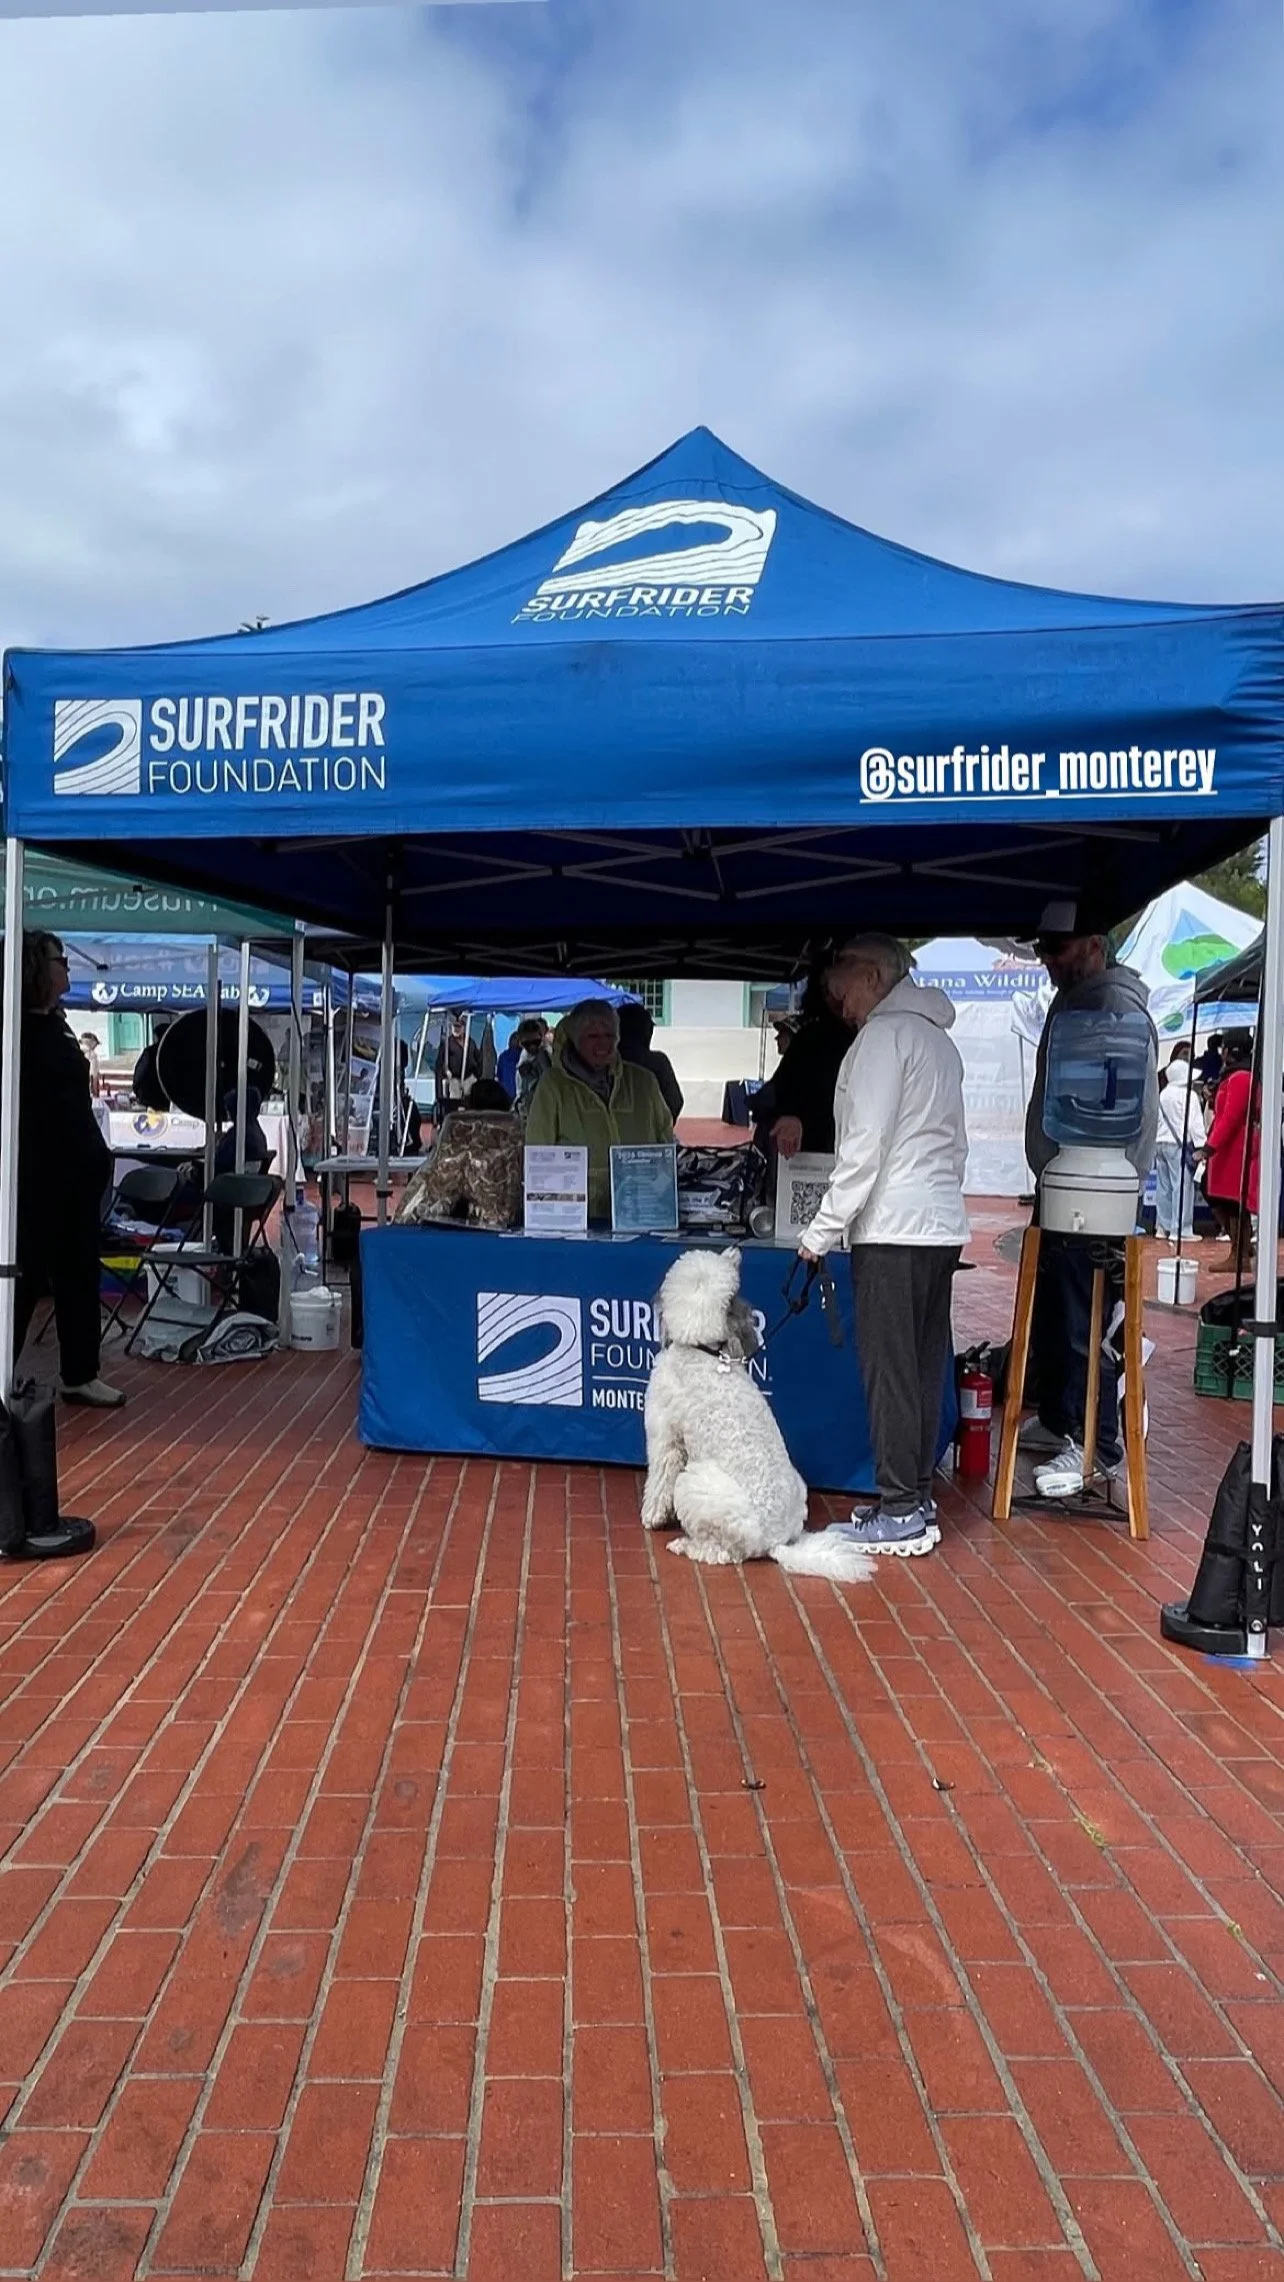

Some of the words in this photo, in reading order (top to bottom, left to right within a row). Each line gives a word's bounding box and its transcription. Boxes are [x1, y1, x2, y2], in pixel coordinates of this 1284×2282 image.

[521, 587, 753, 613] SURFRIDER
[510, 604, 750, 625] FOUNDATION
[149, 692, 386, 752] SURFRIDER
[149, 755, 386, 794] FOUNDATION
[860, 744, 1217, 803] @surfrider_monterey
[120, 982, 168, 1002] Camp
[171, 983, 206, 999] SEA
[919, 975, 967, 988] tana
[592, 1388, 645, 1411] MONTE
